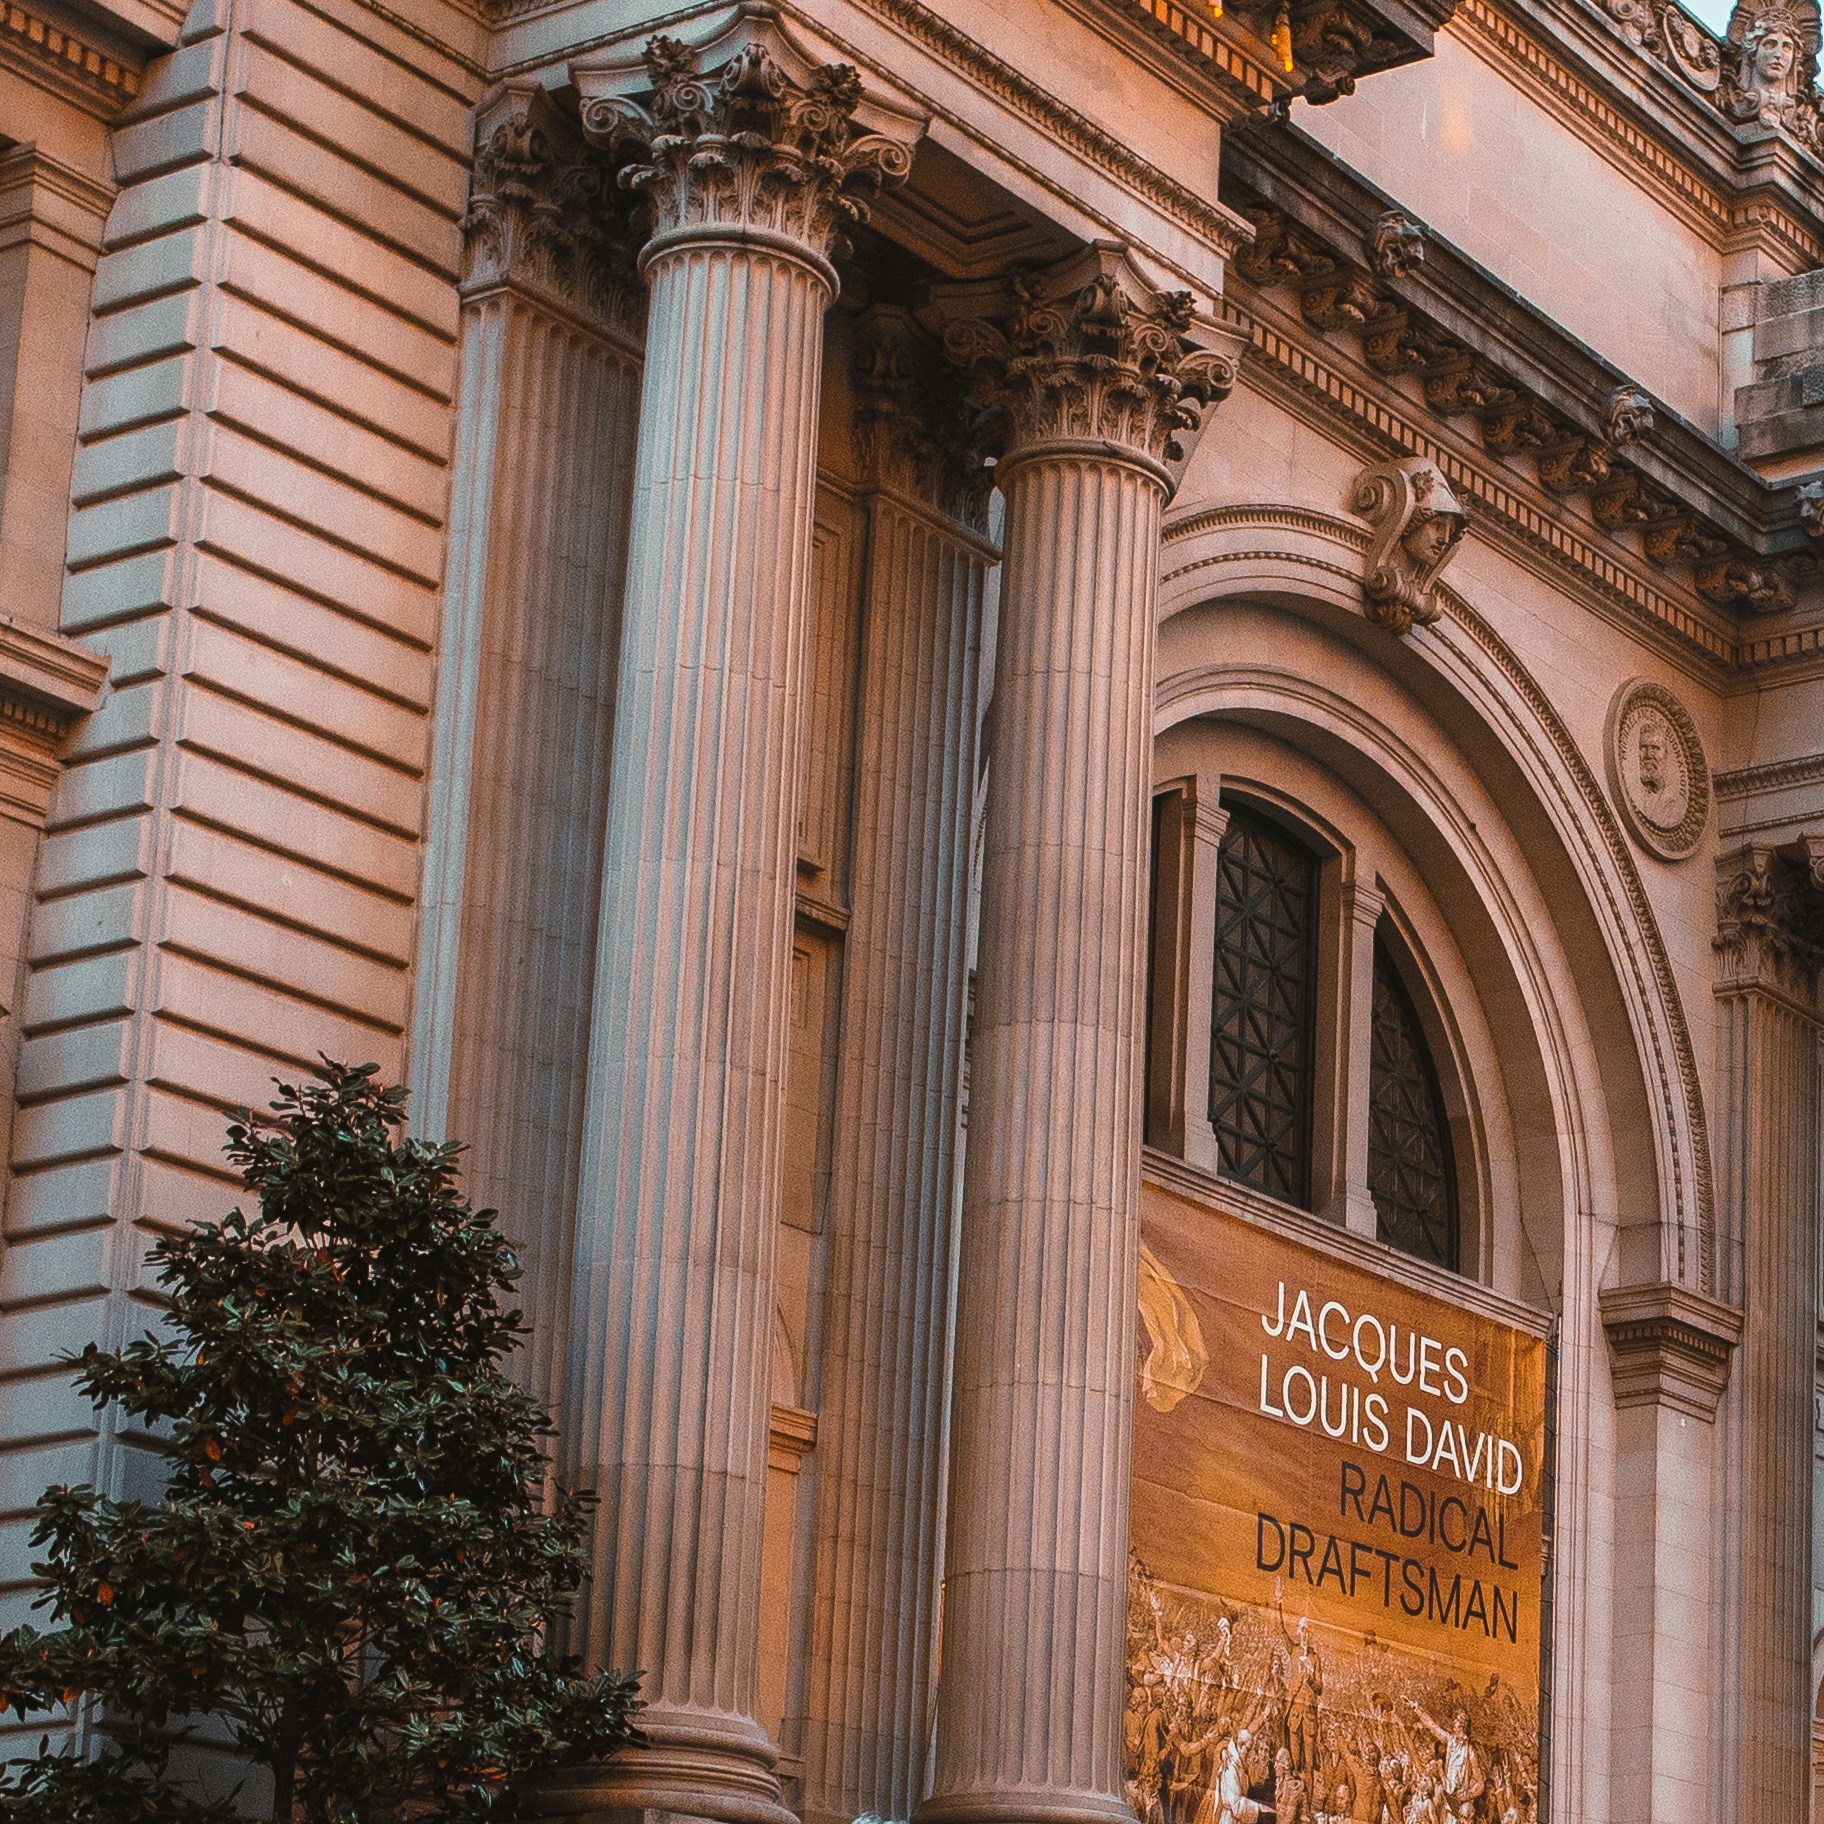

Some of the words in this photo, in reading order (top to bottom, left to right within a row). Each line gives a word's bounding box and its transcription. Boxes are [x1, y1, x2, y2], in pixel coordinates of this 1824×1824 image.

[1261, 1281, 1468, 1403] JACQUES
[1260, 1354, 1388, 1451] LOUIS
[1407, 1407, 1522, 1494] DAVID
[1257, 1512, 1517, 1643] DRAFTSMAN
[1341, 1461, 1518, 1570] RADICAL
